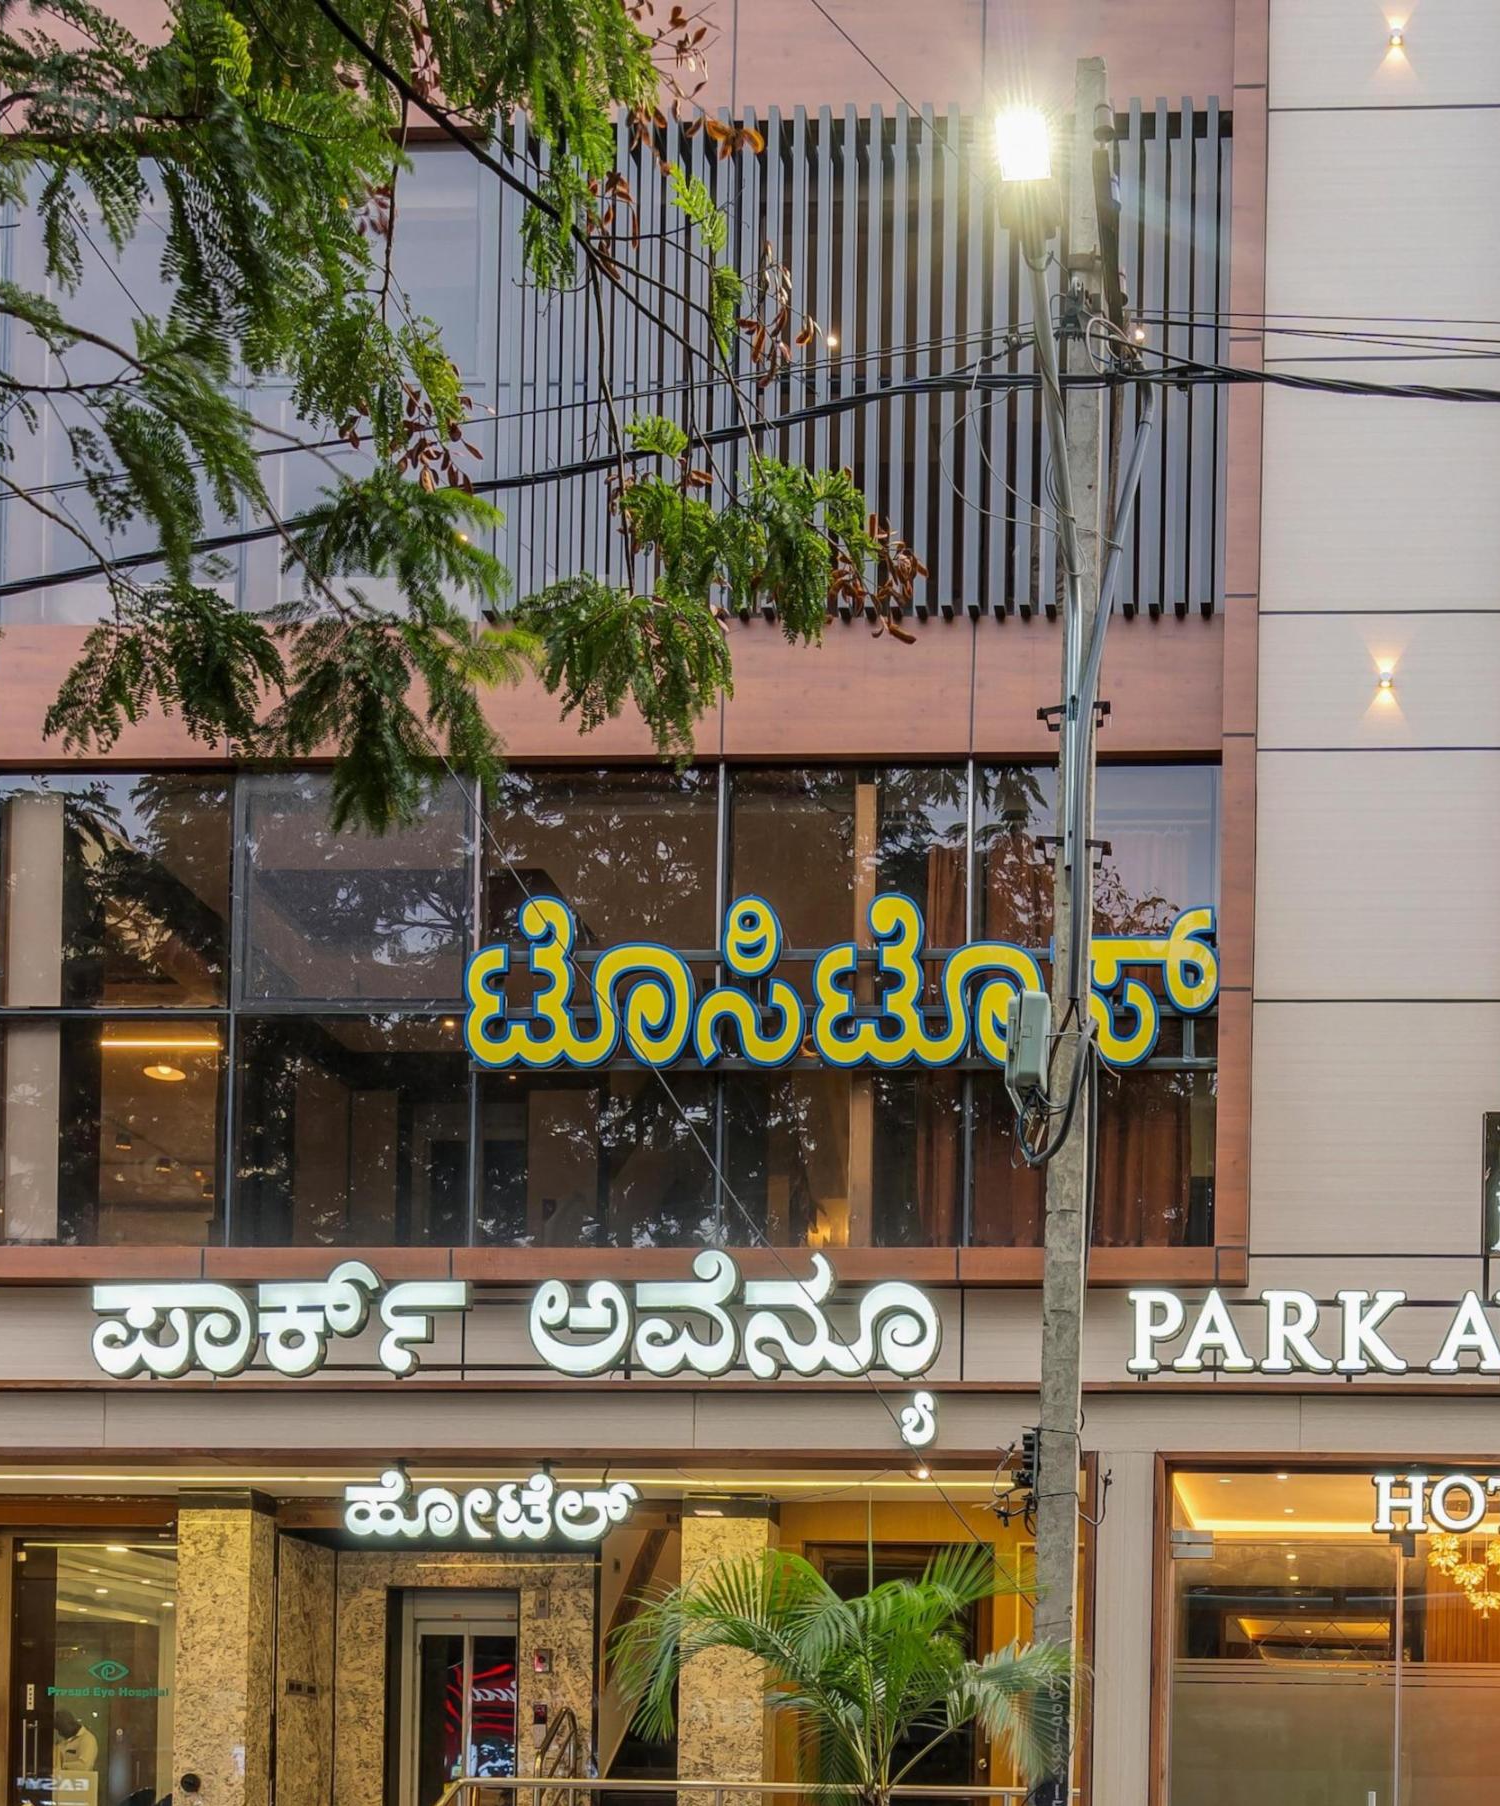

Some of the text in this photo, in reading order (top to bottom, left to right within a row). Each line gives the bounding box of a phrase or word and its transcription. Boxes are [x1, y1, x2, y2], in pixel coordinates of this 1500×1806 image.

[1126, 1288, 1408, 1374] PARK
[345, 1469, 639, 1541] ಹೋಟೆಲ್
[93, 1687, 115, 1699] Eye
[119, 1687, 169, 1698] Hospital
